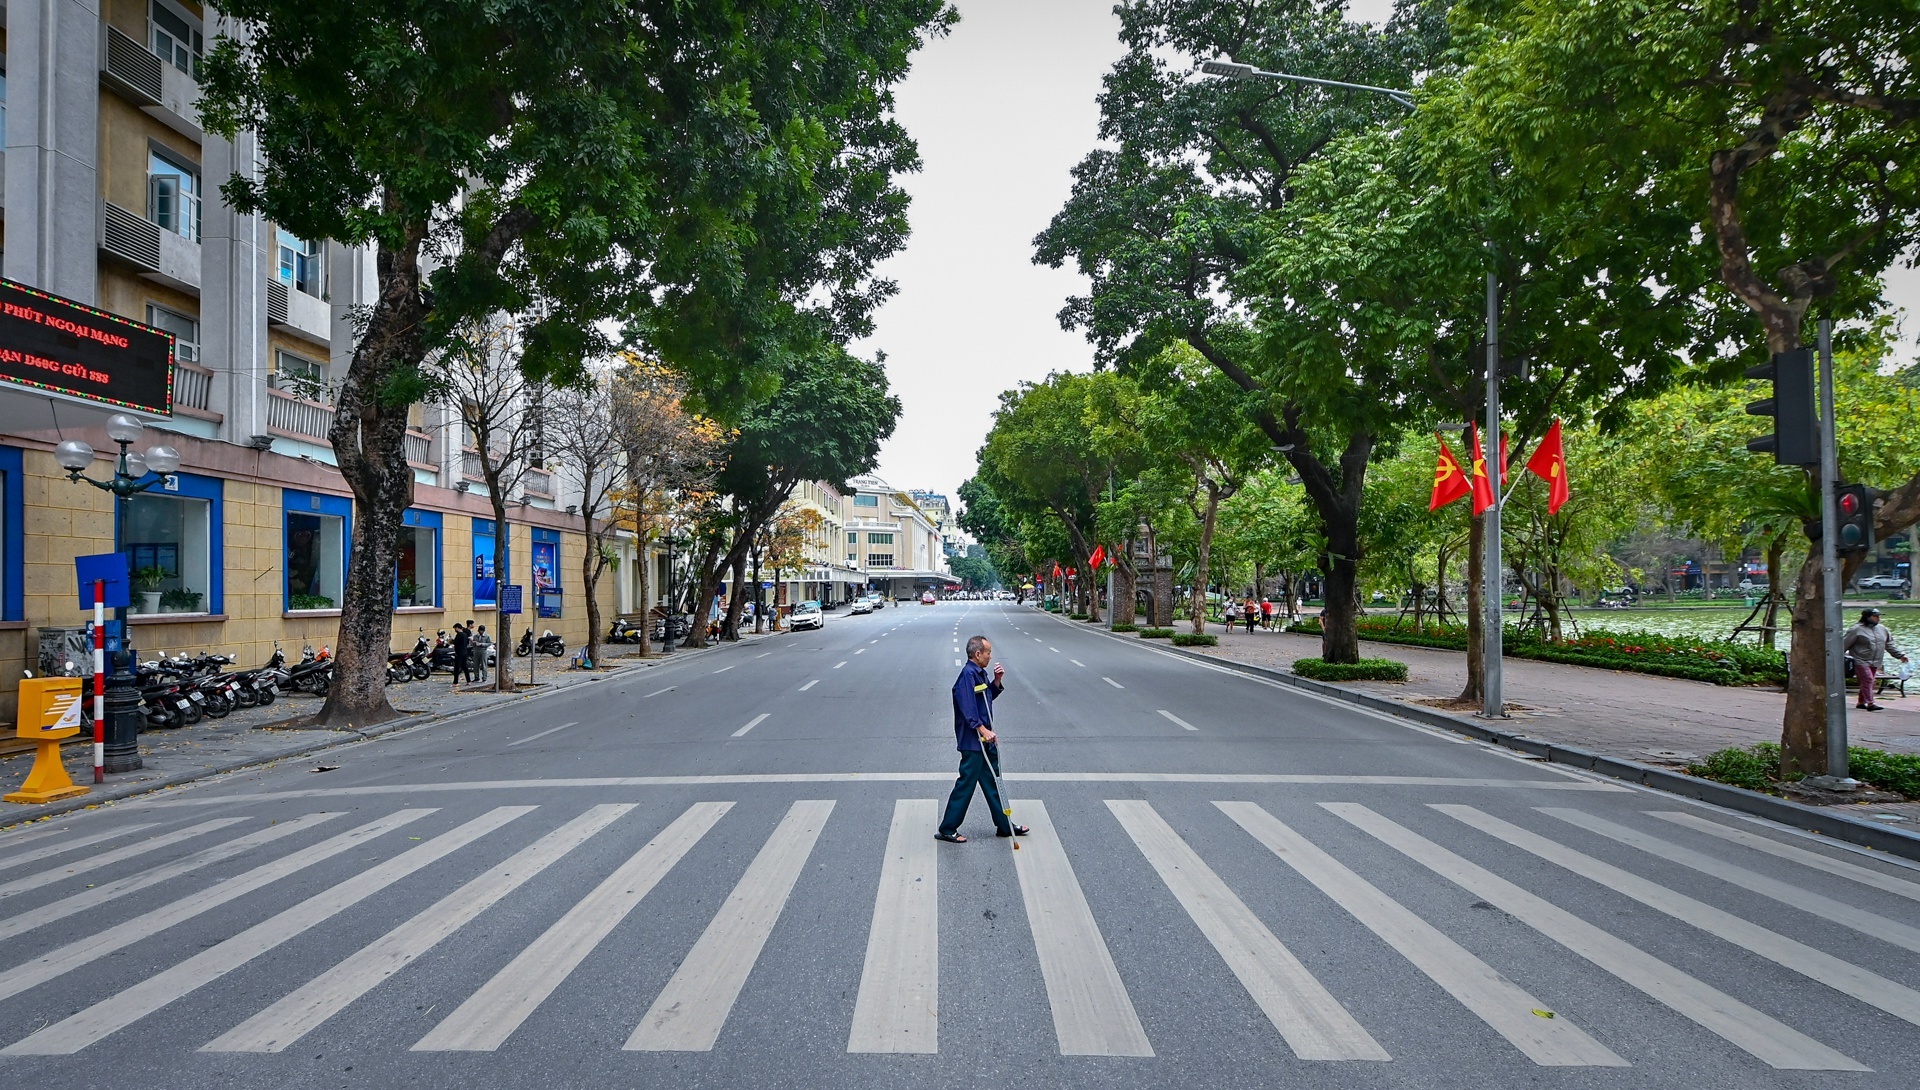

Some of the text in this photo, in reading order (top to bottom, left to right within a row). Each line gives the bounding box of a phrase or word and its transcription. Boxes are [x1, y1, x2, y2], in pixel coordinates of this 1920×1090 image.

[4, 303, 43, 324] PHÚT
[45, 315, 89, 337] NGOẠI
[91, 328, 128, 348] MẠNG
[0, 349, 22, 362] ẠN
[62, 363, 88, 379] GỬI
[89, 370, 109, 384] 888
